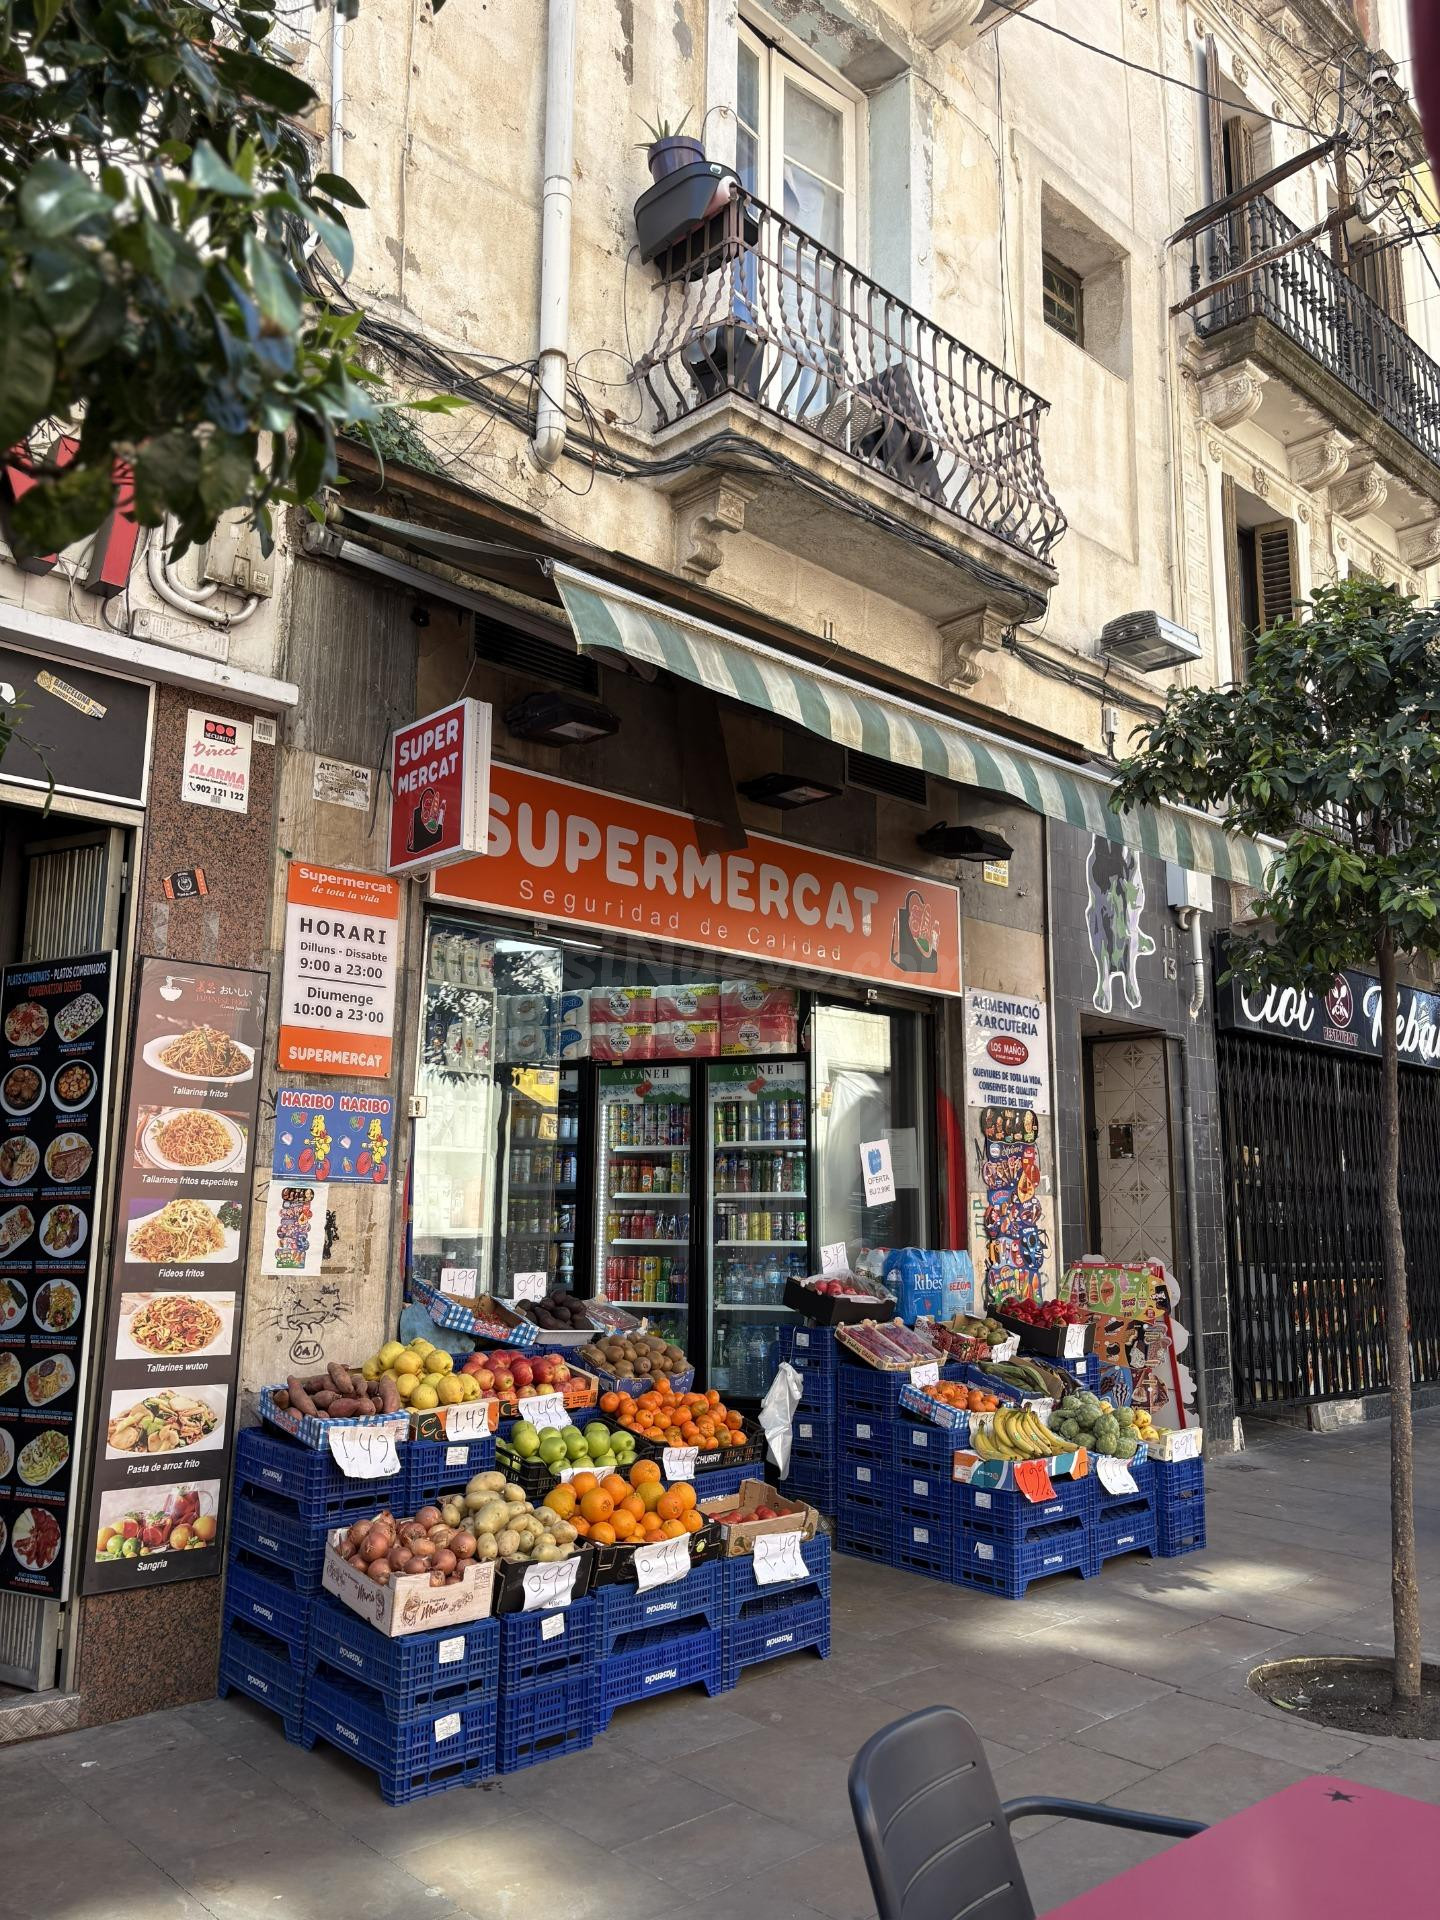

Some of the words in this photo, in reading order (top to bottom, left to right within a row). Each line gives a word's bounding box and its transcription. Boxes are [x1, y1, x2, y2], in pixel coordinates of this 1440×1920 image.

[53, 678, 91, 705] BARCELONA
[205, 732, 235, 743] SECURITAS
[400, 717, 459, 766] SUPER
[193, 740, 244, 757] Direct
[188, 763, 245, 785] ALARMA
[398, 752, 459, 796] MERCAT
[196, 784, 211, 794] 902
[214, 788, 227, 797] 121
[231, 792, 244, 801] 122
[486, 795, 878, 937] SUPERMERCAT
[299, 867, 393, 894] Supermercat
[312, 885, 323, 895] de
[326, 887, 345, 898] tota
[347, 889, 357, 900] la
[359, 891, 380, 903] vida
[520, 879, 680, 930] Seguridad
[700, 912, 728, 939] de
[747, 927, 841, 961] Calidad
[300, 917, 387, 945] HORARI
[1163, 924, 1174, 949] 11
[300, 942, 336, 955] Dilluns
[346, 948, 388, 963] Dissabte
[54, 966, 73, 980] PLATOS
[73, 962, 107, 977] COMBINADOS
[300, 957, 330, 972] 9:00
[334, 963, 342, 974] a
[346, 964, 383, 979] 23:00
[1163, 956, 1177, 980] 13
[220, 985, 253, 997] おいしい
[307, 986, 373, 1007] Diumenge
[293, 1003, 332, 1018] 10:00
[336, 1008, 344, 1019] a
[972, 996, 1040, 1020] ALIMENTACIÓ
[975, 1014, 1038, 1036] XARCUTERIA
[289, 1046, 383, 1068] SUPERMERCAT
[990, 1042, 1002, 1052] LOS
[1003, 1043, 1025, 1056] MAÑOS
[621, 1069, 669, 1080] AFANEH
[732, 1064, 784, 1077] AFANEH
[1002, 1072, 1009, 1080] DE
[1022, 1075, 1029, 1083] LA
[172, 1085, 208, 1098] Tallarines
[209, 1087, 229, 1099] fritos
[978, 1080, 1007, 1093] CONSERVES
[1008, 1085, 1015, 1094] DE
[281, 1091, 334, 1110] HARIBO
[340, 1095, 391, 1113] HARIBO
[987, 1095, 1007, 1106] FRUITES
[1008, 1097, 1018, 1106] DEL
[142, 1174, 178, 1187] Tallarines
[180, 1175, 199, 1187] fritos
[200, 1176, 239, 1188] especiales
[868, 1174, 890, 1185] OFERTA
[158, 1267, 180, 1279] Fideos
[181, 1267, 205, 1279] fritos
[914, 1273, 943, 1290] Ribes
[146, 1362, 183, 1373] Tallarines
[185, 1361, 208, 1371] wuton
[126, 1463, 149, 1475] Pasta
[151, 1461, 161, 1472] de
[162, 1460, 183, 1472] arroz
[184, 1458, 201, 1470] frito
[137, 1558, 168, 1573] Sangria
[646, 1600, 678, 1615] Plasencia
[766, 1632, 793, 1647] Plasencia
[645, 1668, 677, 1685] Plasencia
